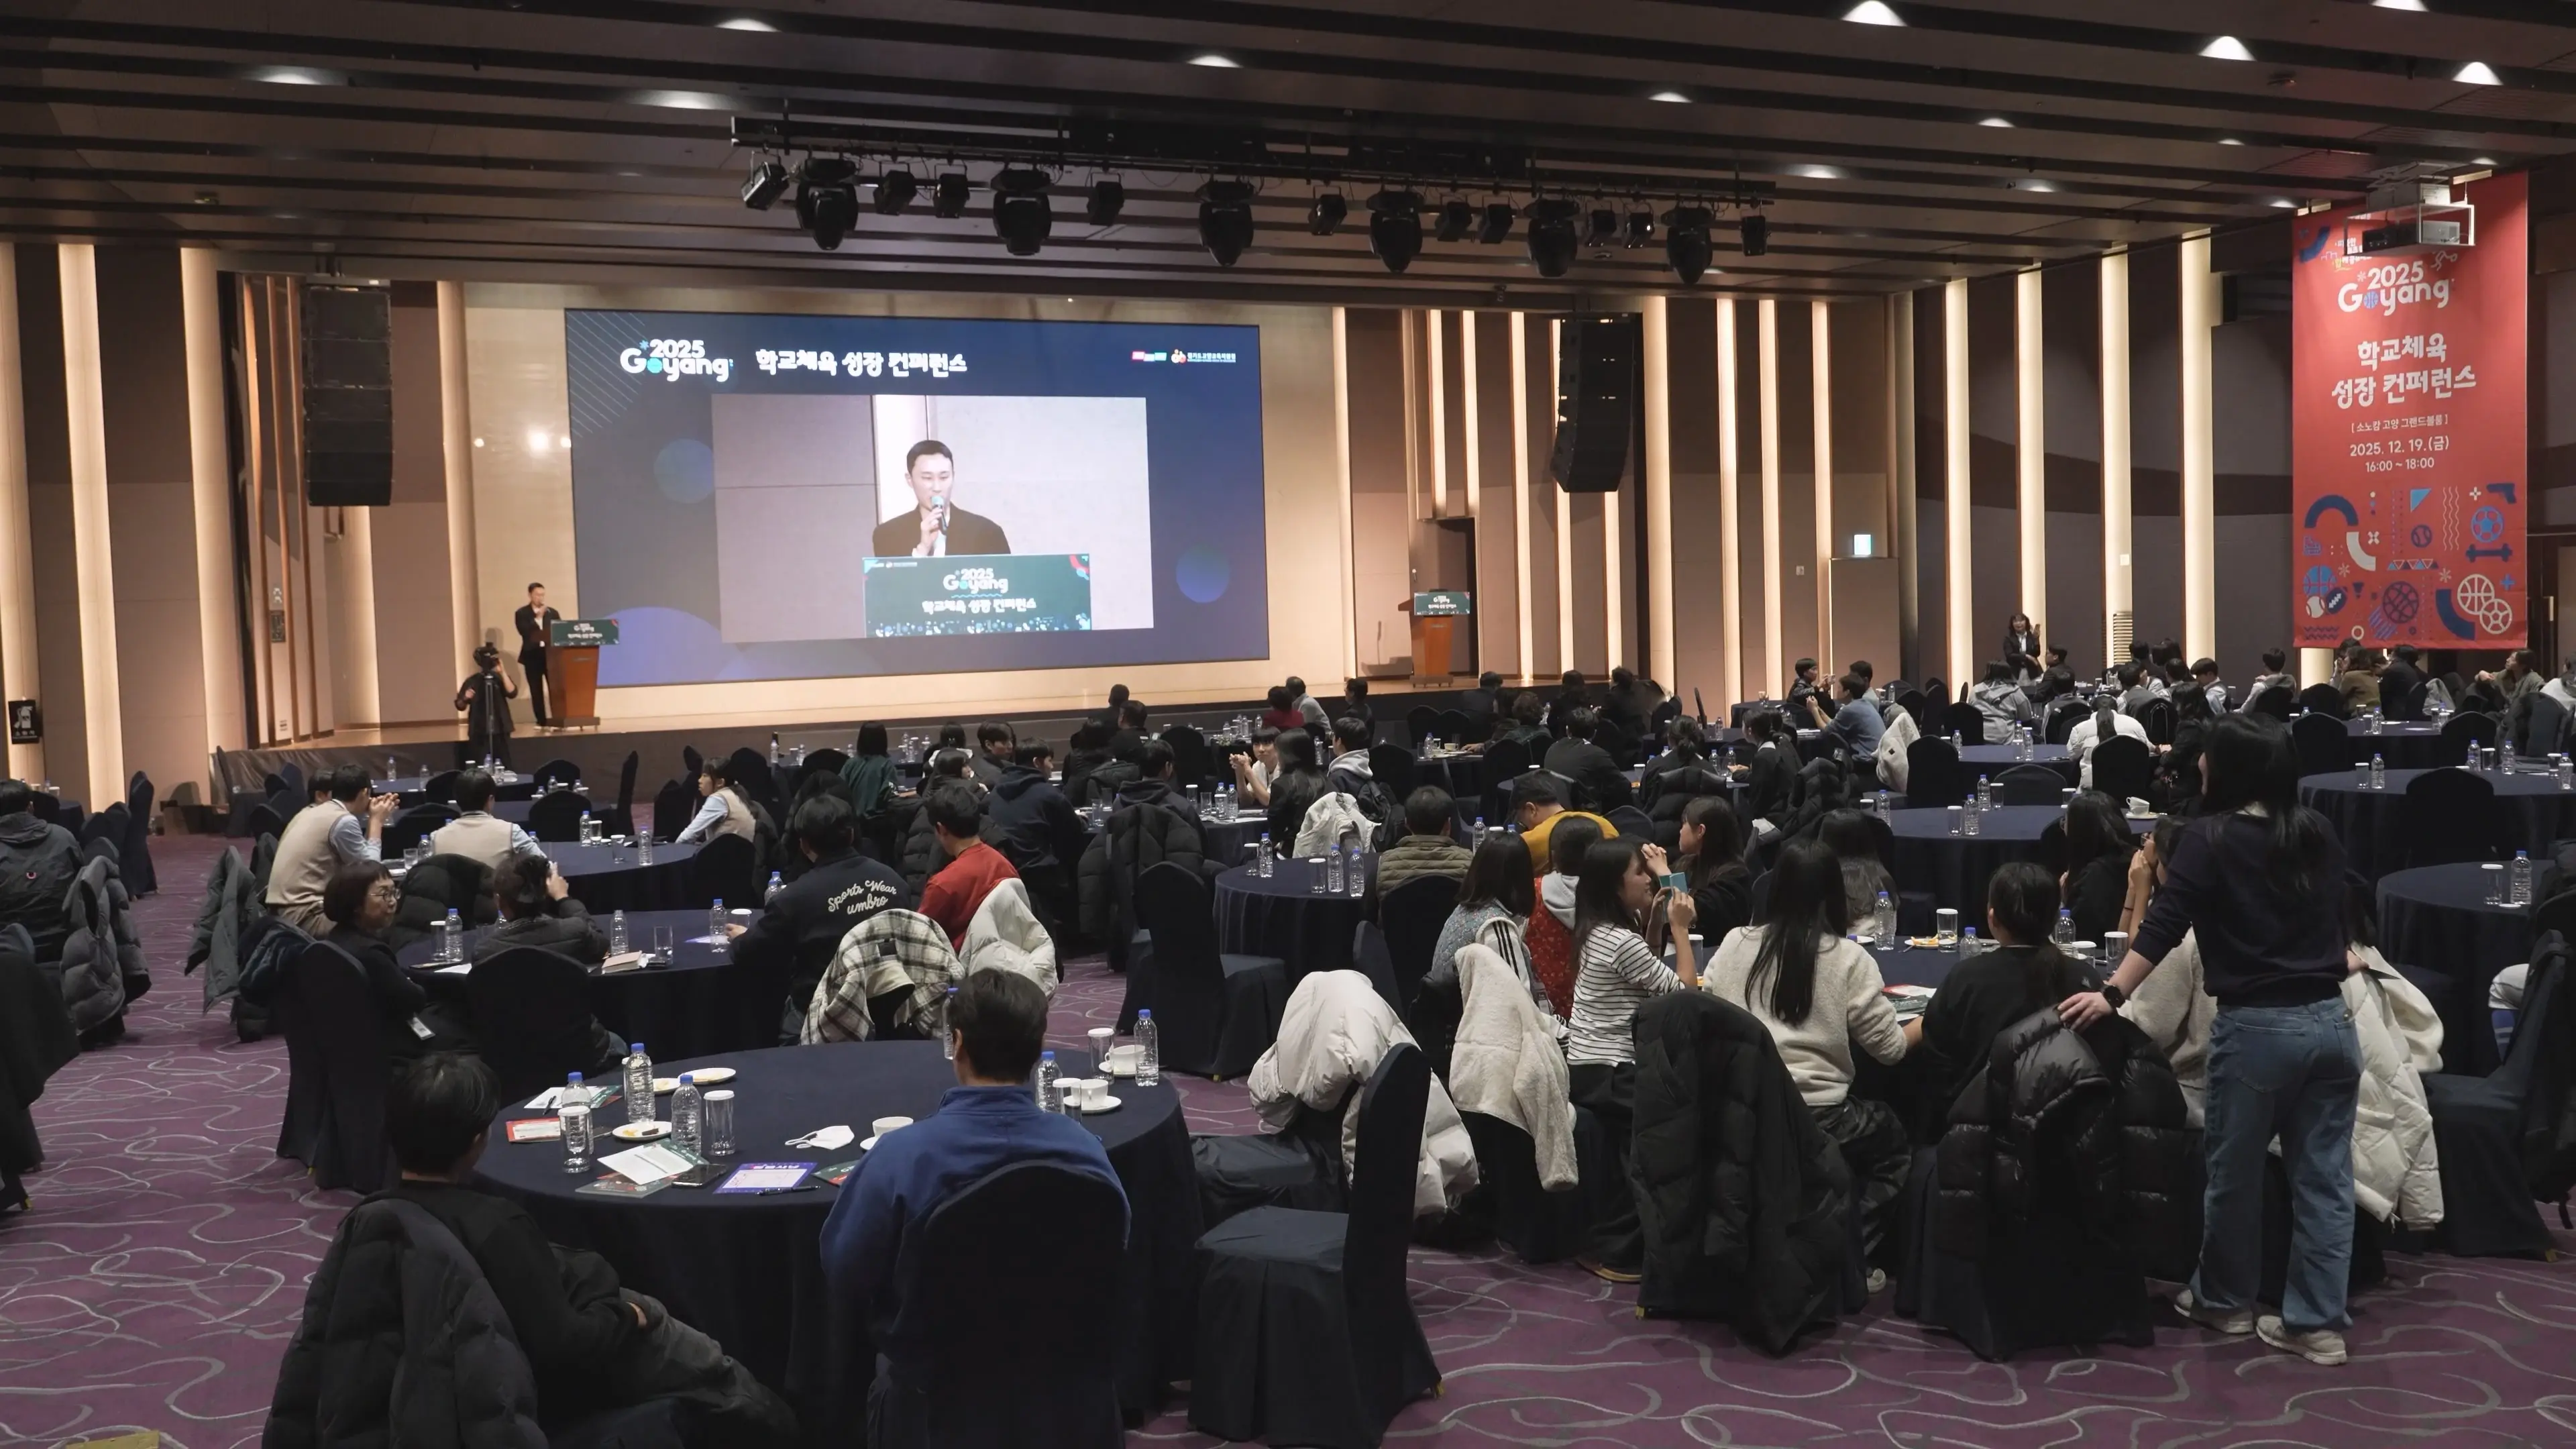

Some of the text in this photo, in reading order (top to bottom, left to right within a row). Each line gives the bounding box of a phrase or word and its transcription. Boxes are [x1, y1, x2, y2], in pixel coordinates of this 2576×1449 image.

[2367, 260, 2424, 290] 2025
[2338, 279, 2449, 316] Goyang
[649, 339, 705, 358] 2025
[2357, 333, 2447, 371] 학교체육
[620, 347, 729, 382] Goyang
[755, 349, 968, 377] 학교체육 성장 컨퍼런스
[2331, 365, 2477, 409] 성장 컨퍼런스
[2357, 420, 2381, 432] 소노캄
[2382, 419, 2400, 430] 고양
[2350, 443, 2384, 457] 2025.
[2388, 440, 2405, 453] 12.
[2365, 460, 2393, 473] 16:00
[2405, 457, 2434, 470] 18:00
[960, 568, 994, 581] 2025
[828, 880, 897, 912] Sports Wear
[847, 894, 888, 914] umbro
